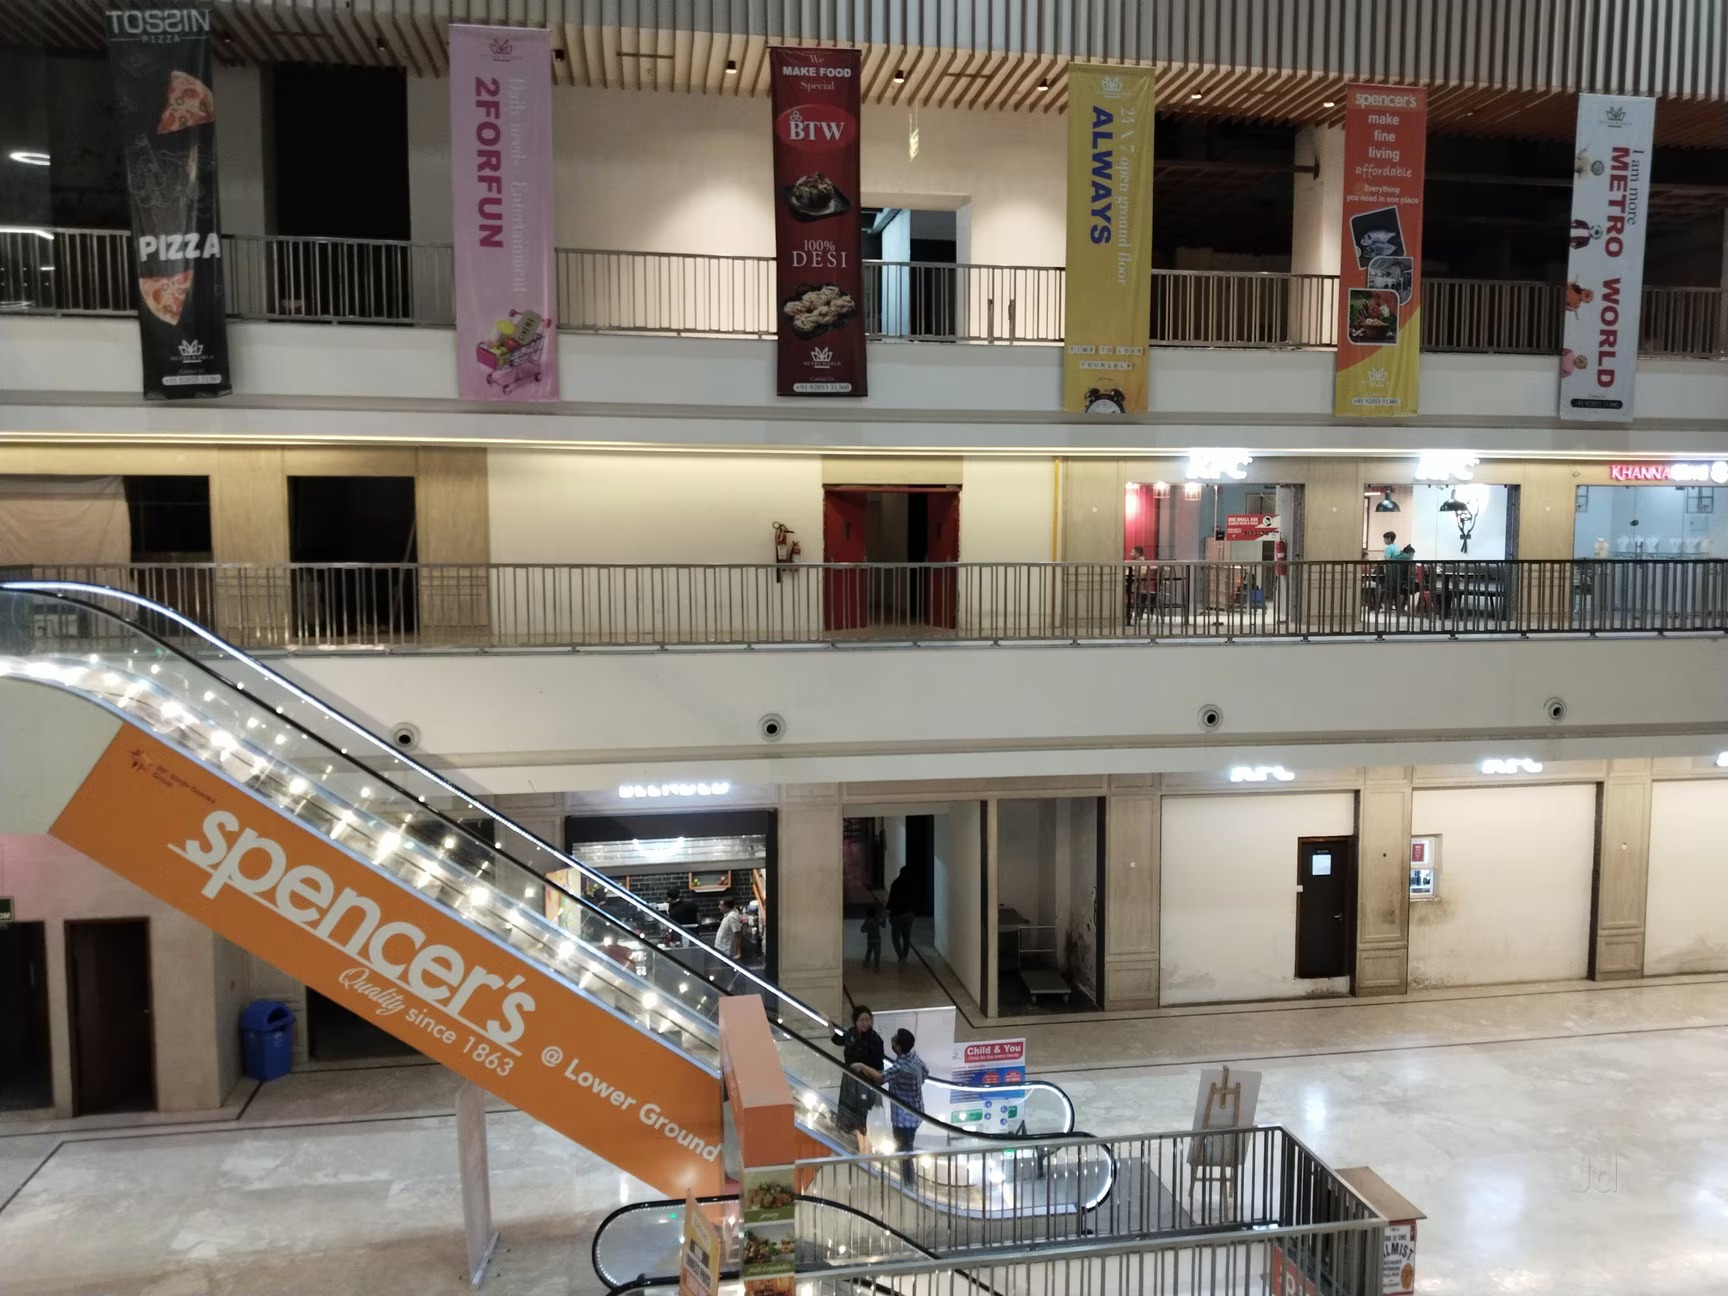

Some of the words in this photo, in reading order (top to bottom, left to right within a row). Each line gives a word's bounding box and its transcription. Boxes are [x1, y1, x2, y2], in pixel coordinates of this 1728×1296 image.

[105, 9, 210, 34] TOSSIN
[141, 34, 180, 44] PIZZA
[809, 53, 825, 64] We
[782, 66, 816, 77] MAKE
[819, 67, 852, 78] FOOD
[800, 80, 835, 92] Special
[1355, 93, 1416, 109] spencer's
[1368, 113, 1400, 125] make
[788, 119, 845, 141] BTW
[1374, 129, 1396, 142] fine
[1120, 144, 1135, 153] 7
[1368, 146, 1400, 162] living
[474, 76, 503, 249] 2FORFUN
[1355, 164, 1412, 179] affordable
[1629, 159, 1640, 183] am
[1090, 105, 1114, 245] ALWAYS
[1114, 157, 1129, 192] open
[1364, 184, 1400, 195] Everything
[1346, 194, 1359, 202] you
[1360, 194, 1377, 202] need
[1400, 196, 1418, 205] place
[1604, 146, 1631, 258] METRO
[1626, 187, 1638, 225] more
[1115, 195, 1132, 248] ground
[138, 232, 220, 262] PIZZA
[804, 240, 835, 252] 100%
[792, 251, 848, 268] DESI
[1117, 252, 1132, 286] floor
[1597, 278, 1621, 389] WORLD
[184, 809, 537, 1046] spencer's
[337, 966, 406, 1017] Quality
[404, 1006, 458, 1046] since
[461, 1035, 516, 1078] 1863
[967, 1045, 991, 1056] Child
[993, 1044, 1001, 1054] &
[1003, 1044, 1021, 1053] You
[540, 1045, 564, 1068] @
[563, 1057, 638, 1111] Lower
[638, 1102, 722, 1163] Ground
[1383, 1242, 1414, 1261] LMIST
